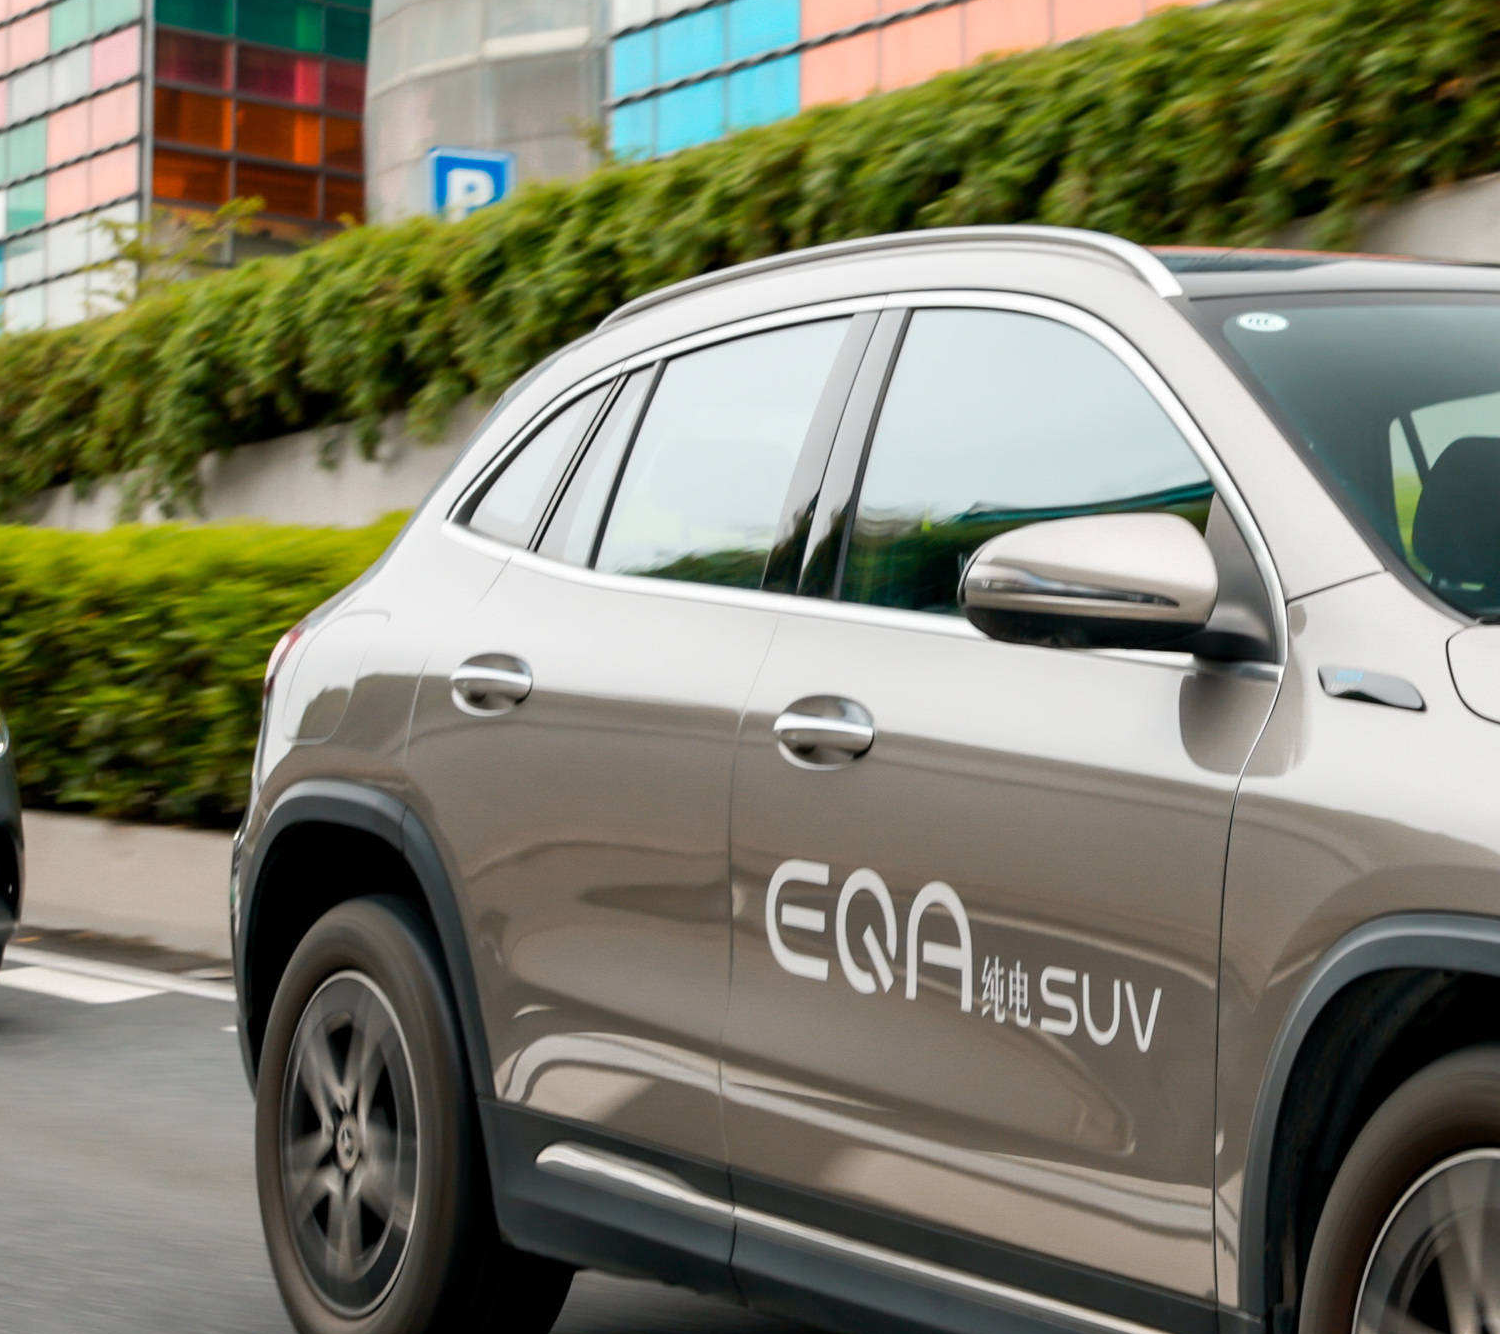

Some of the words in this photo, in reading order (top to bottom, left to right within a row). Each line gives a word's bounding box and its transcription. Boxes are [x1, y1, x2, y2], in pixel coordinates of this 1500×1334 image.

[445, 167, 495, 224] P
[765, 858, 973, 1013] EQA
[981, 955, 1031, 1028] 纯电
[1039, 966, 1162, 1053] SUV
